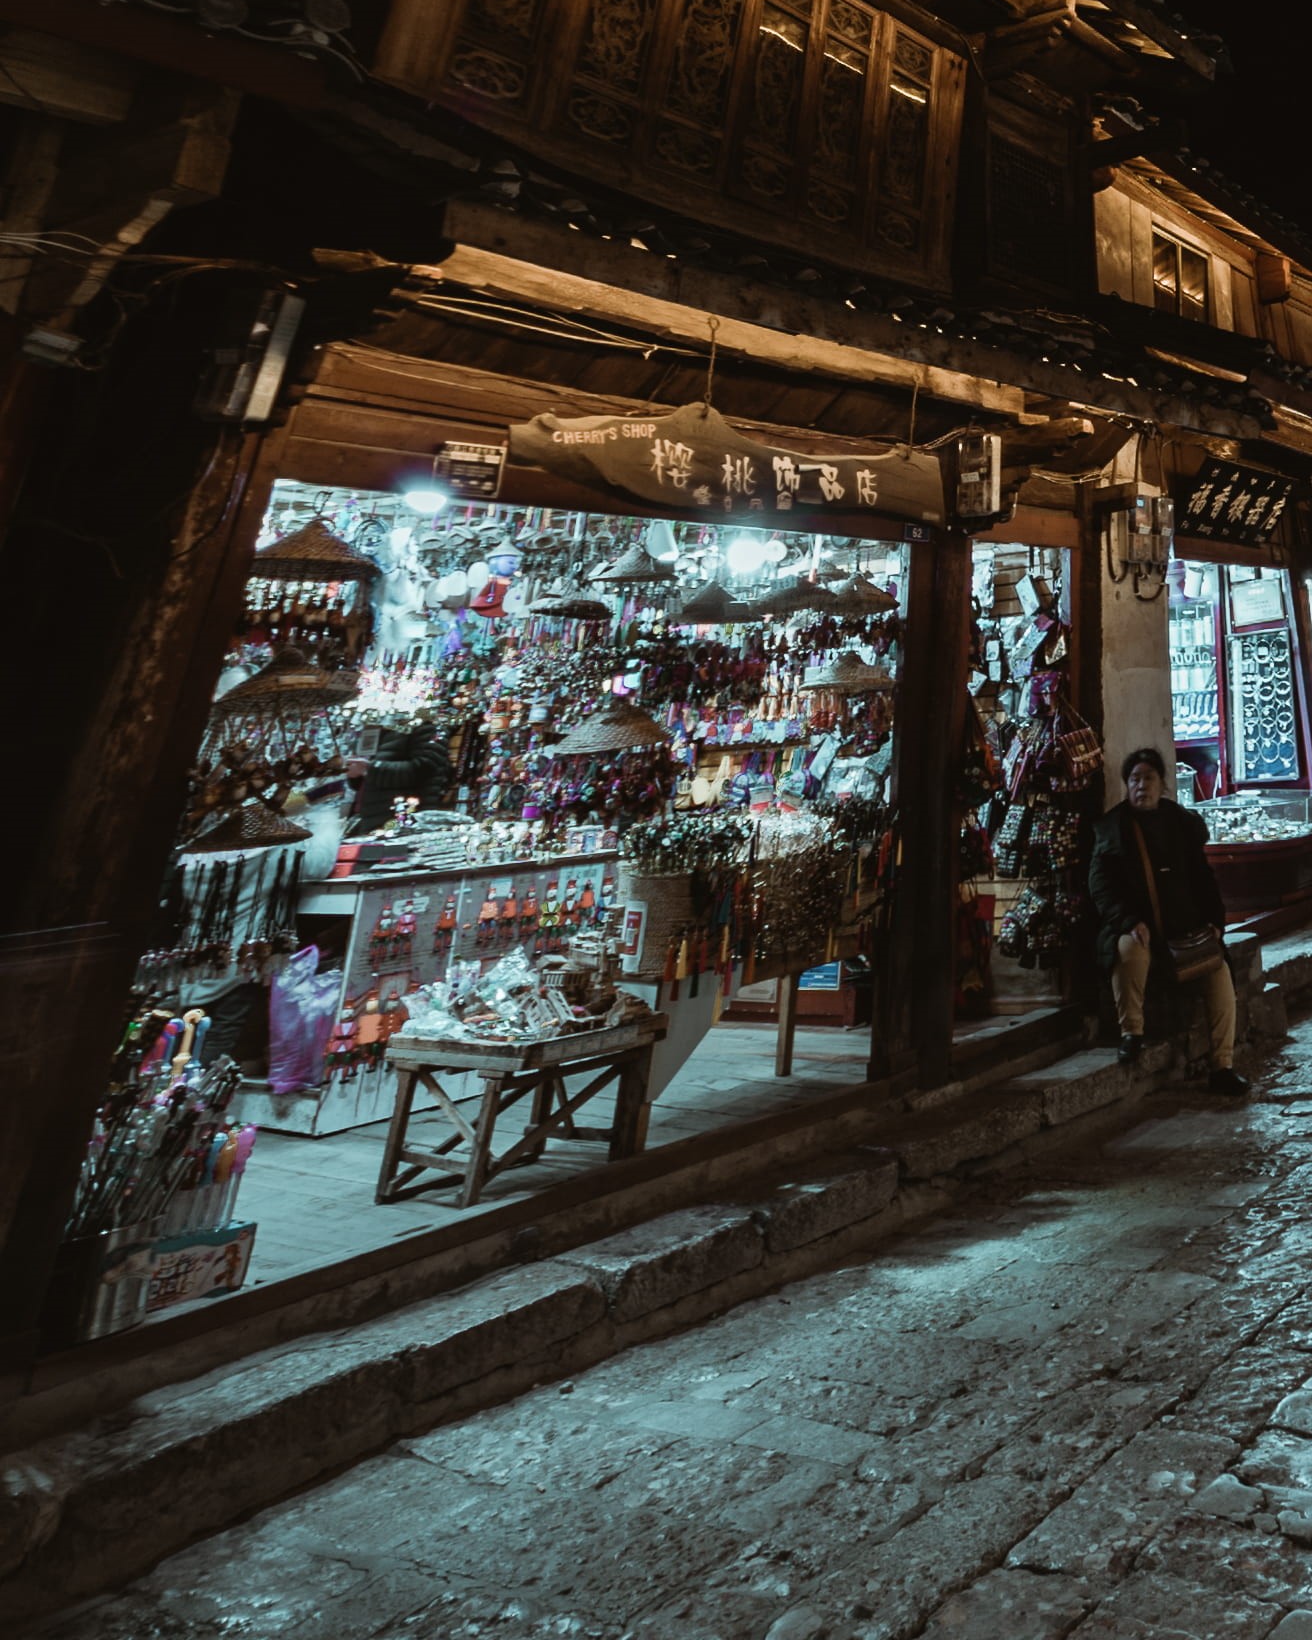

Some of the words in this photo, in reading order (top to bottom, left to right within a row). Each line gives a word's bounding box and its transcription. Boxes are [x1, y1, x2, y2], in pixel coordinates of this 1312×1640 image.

[621, 423, 657, 439] SHOP
[650, 438, 878, 506] 樱桃饰品店
